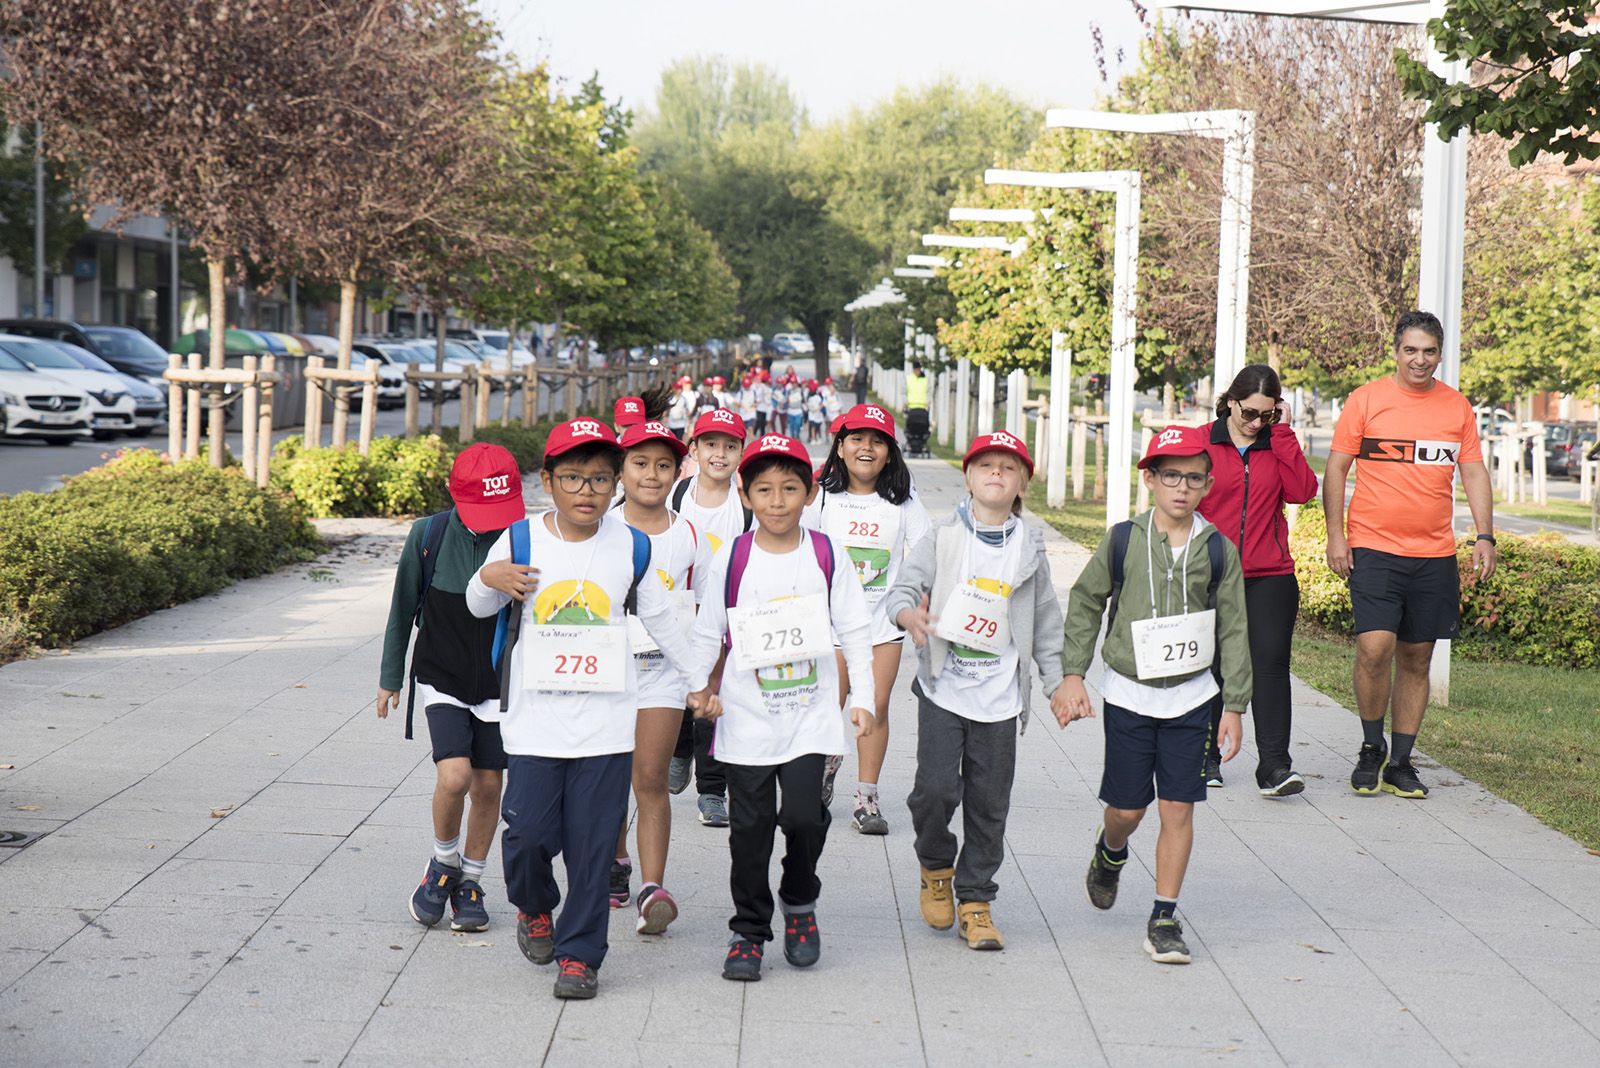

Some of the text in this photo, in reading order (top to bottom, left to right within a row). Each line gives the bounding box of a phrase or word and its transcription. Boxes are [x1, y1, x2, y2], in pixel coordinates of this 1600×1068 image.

[713, 410, 733, 420] TOT
[867, 407, 885, 419] TOT
[570, 421, 600, 433] TOT
[645, 422, 669, 434] TOT
[761, 435, 790, 446] TOT
[992, 432, 1016, 445] TOT
[1159, 429, 1183, 443] TOT
[482, 474, 509, 491] TOT
[848, 521, 879, 537] 282
[964, 614, 998, 638] 279
[761, 627, 803, 651] 278
[1163, 640, 1198, 661] 279
[554, 655, 598, 675] 278
